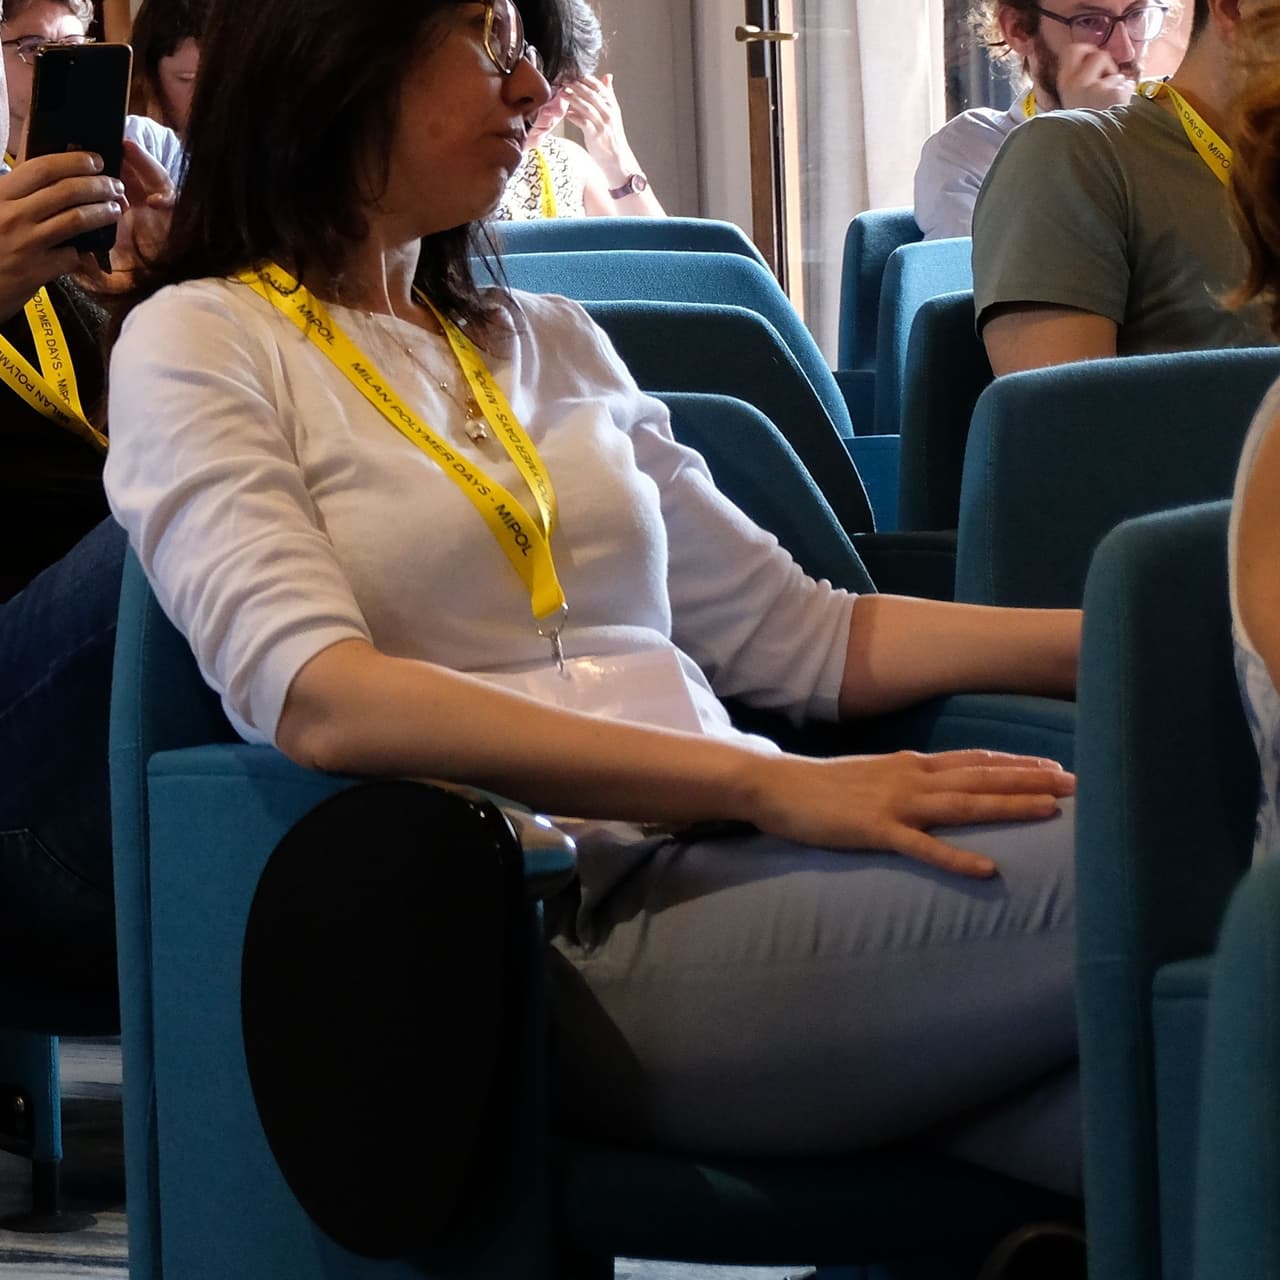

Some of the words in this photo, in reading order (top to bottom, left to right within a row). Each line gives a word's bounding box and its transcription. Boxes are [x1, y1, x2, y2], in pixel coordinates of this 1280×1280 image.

[1183, 111, 1204, 138] DAYS
[1207, 142, 1232, 169] MIPO
[296, 303, 336, 346] MIPOL
[46, 338, 63, 371] DAYS
[57, 378, 71, 405] MIP
[473, 368, 498, 405] MIPOL
[495, 412, 522, 447] DAYS
[351, 361, 393, 403] MILAN
[390, 405, 455, 463] POLYMER
[453, 462, 492, 497] DAYS
[495, 503, 534, 557] MIPOL
